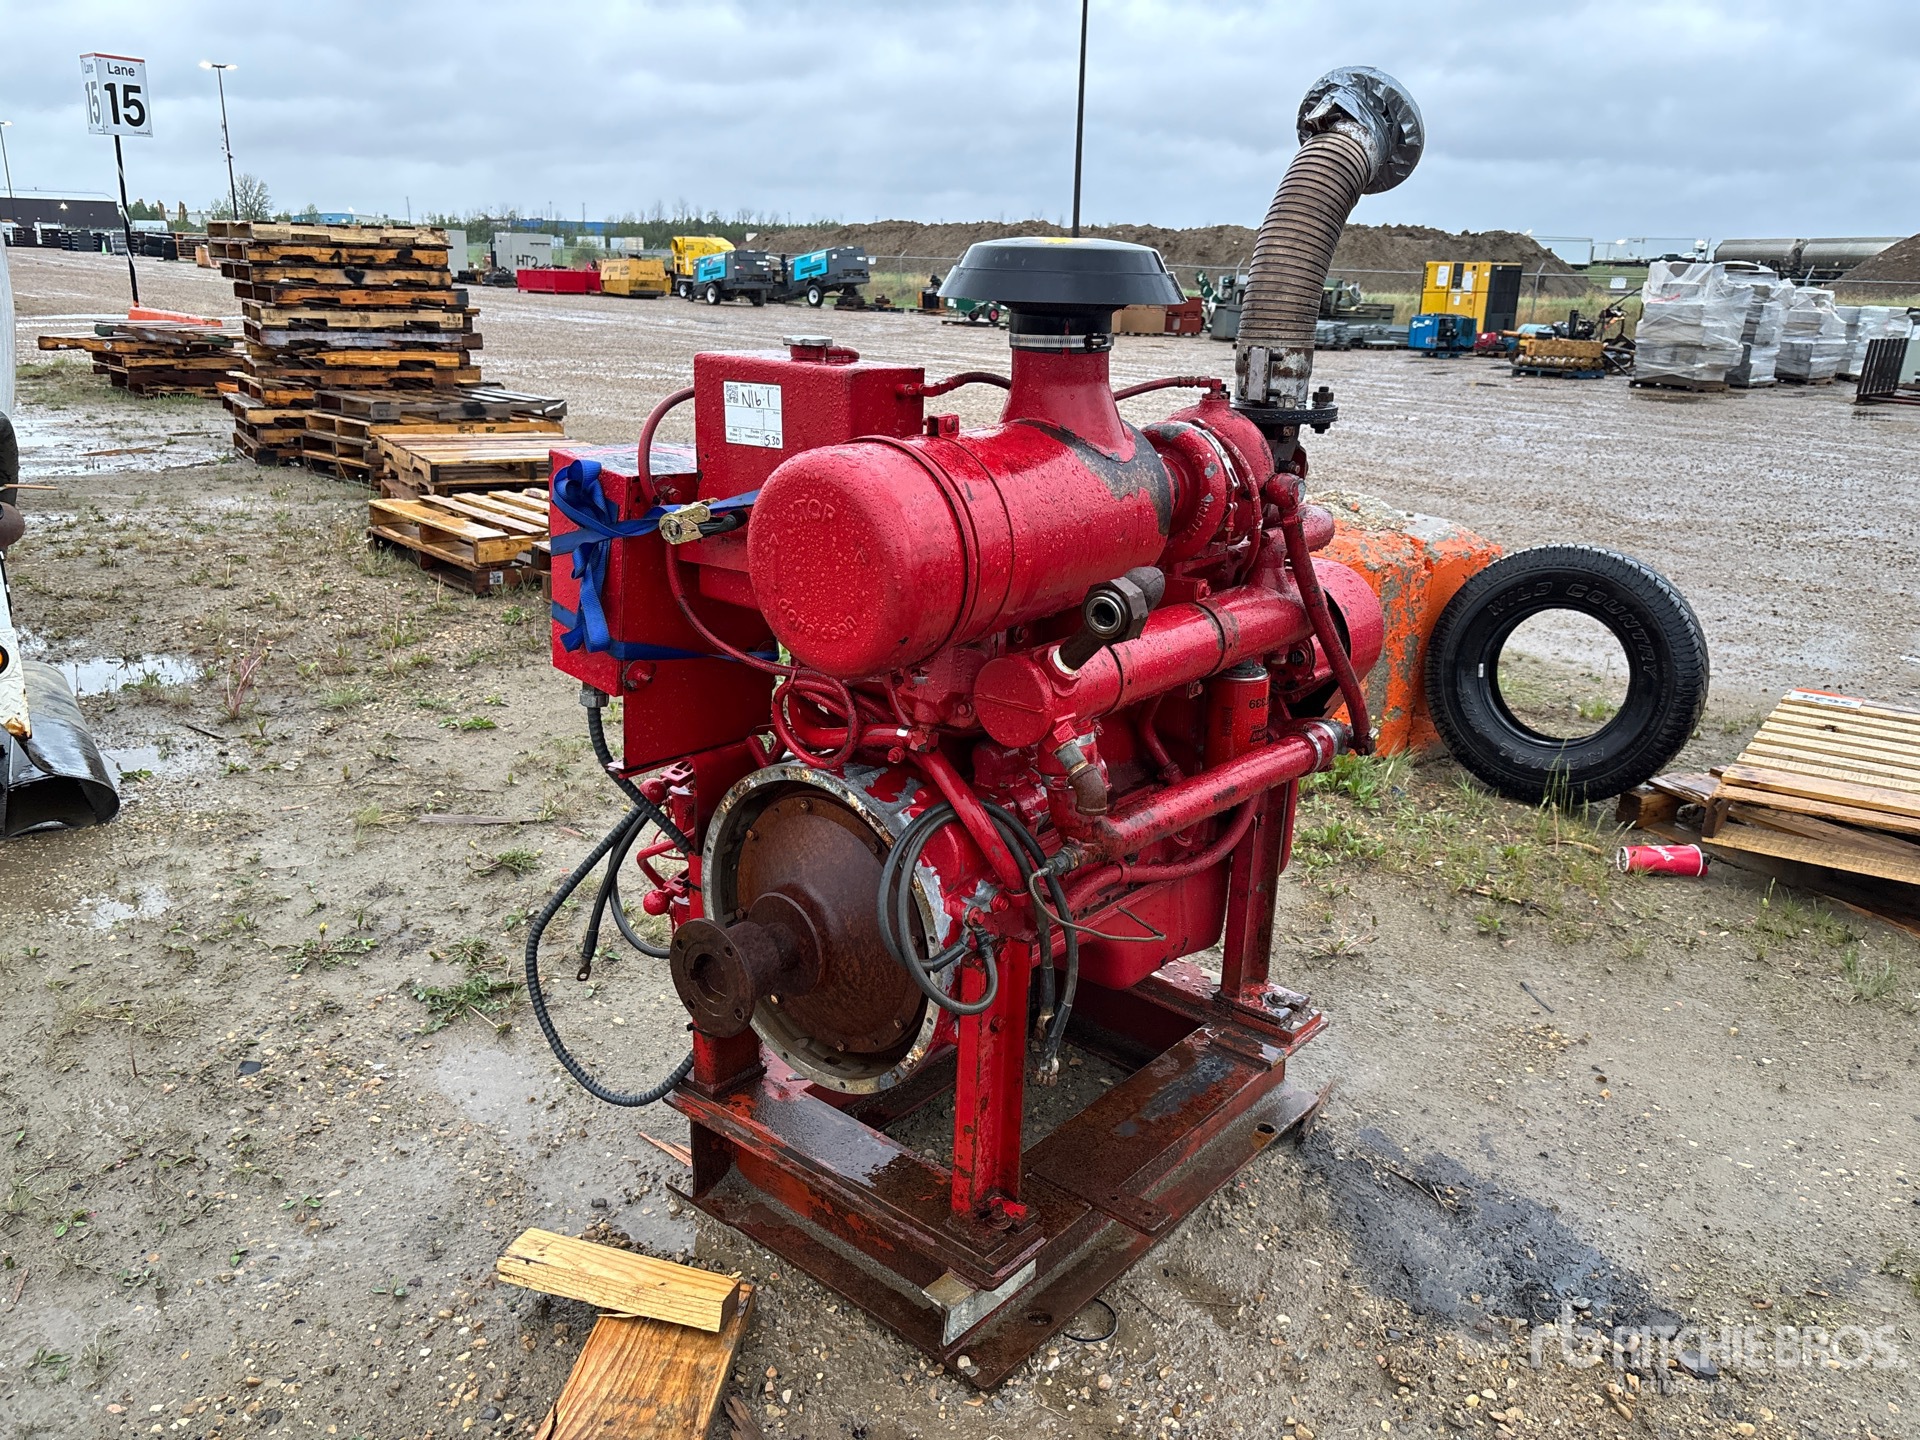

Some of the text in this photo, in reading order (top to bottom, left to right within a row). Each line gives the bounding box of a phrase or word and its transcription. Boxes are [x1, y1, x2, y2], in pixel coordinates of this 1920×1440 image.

[107, 61, 136, 77] Lane
[85, 80, 101, 125] 15
[103, 82, 146, 127] 15
[793, 498, 837, 523] TOP
[1487, 581, 1659, 681] WILD COUNTRY
